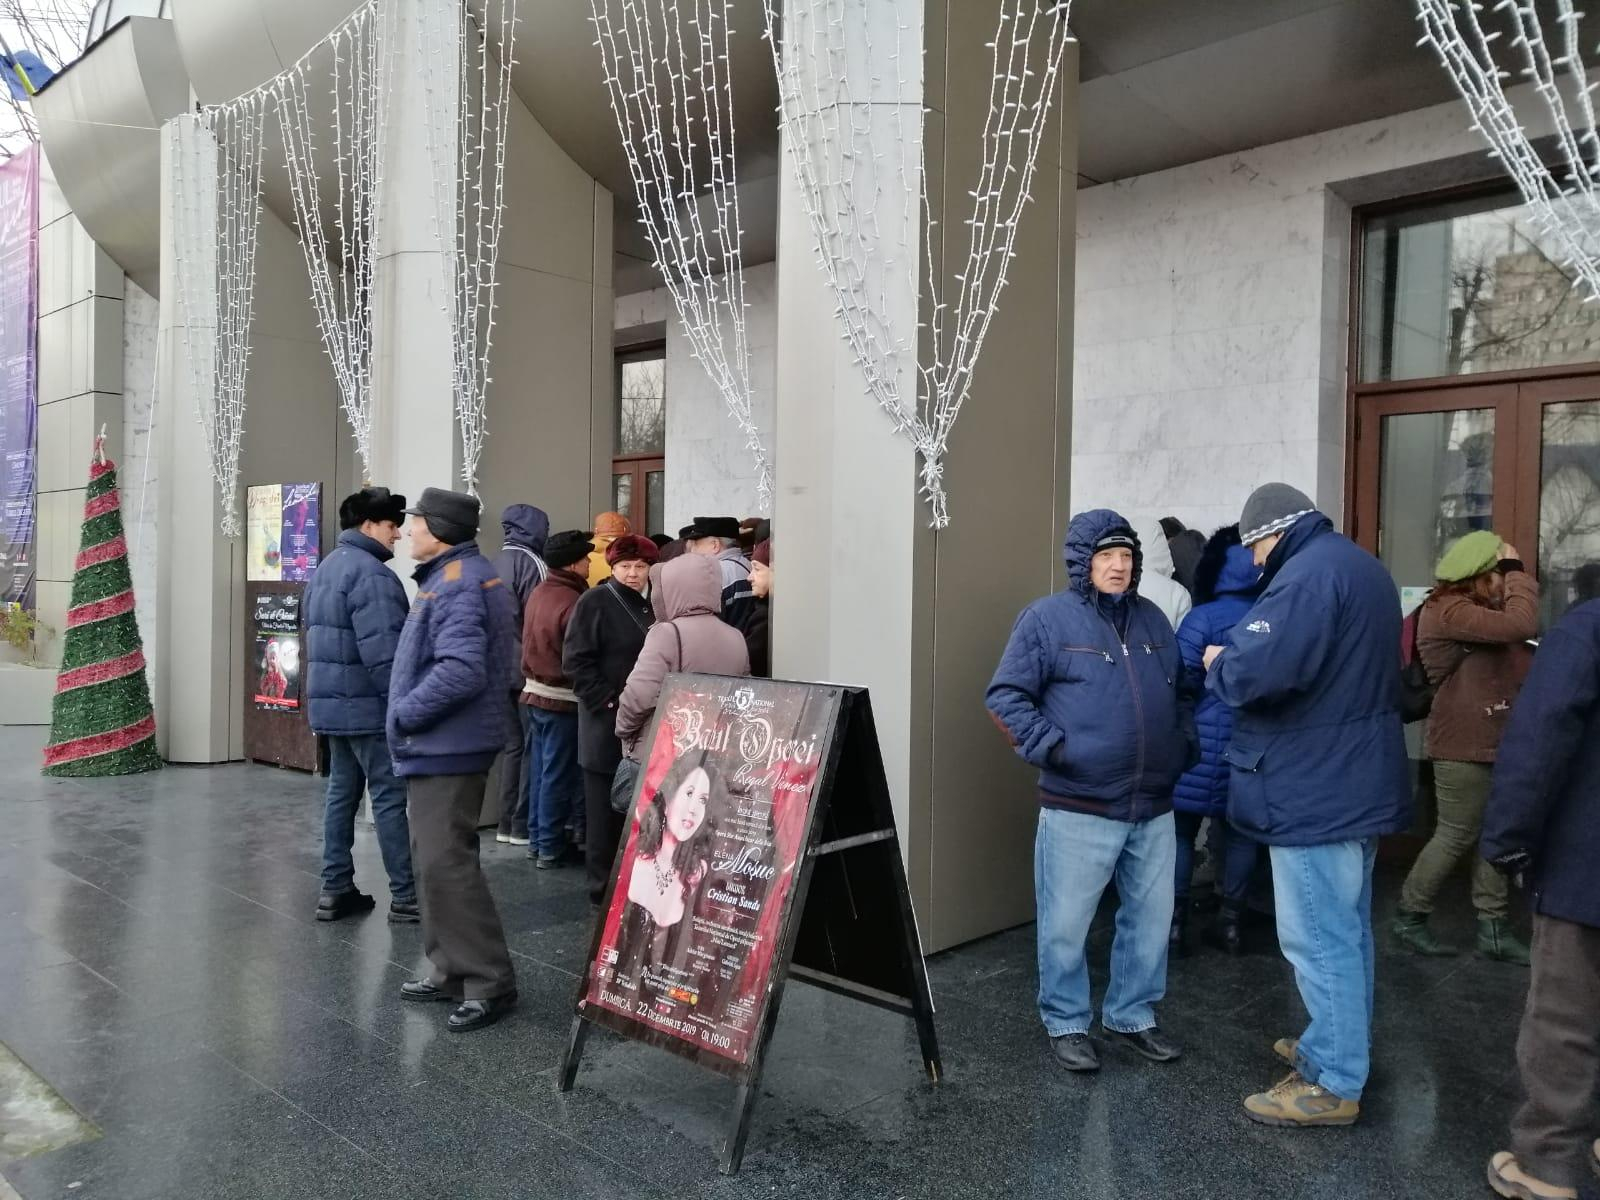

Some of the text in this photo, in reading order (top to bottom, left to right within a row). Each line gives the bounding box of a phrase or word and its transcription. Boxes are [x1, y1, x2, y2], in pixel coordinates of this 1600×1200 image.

[733, 763, 775, 792] Regal
[714, 850, 734, 861] ELENA
[707, 888, 738, 905] Cristian
[636, 1001, 649, 1017] 22
[681, 1022, 697, 1036] 2019
[711, 1032, 731, 1049] 19:00
